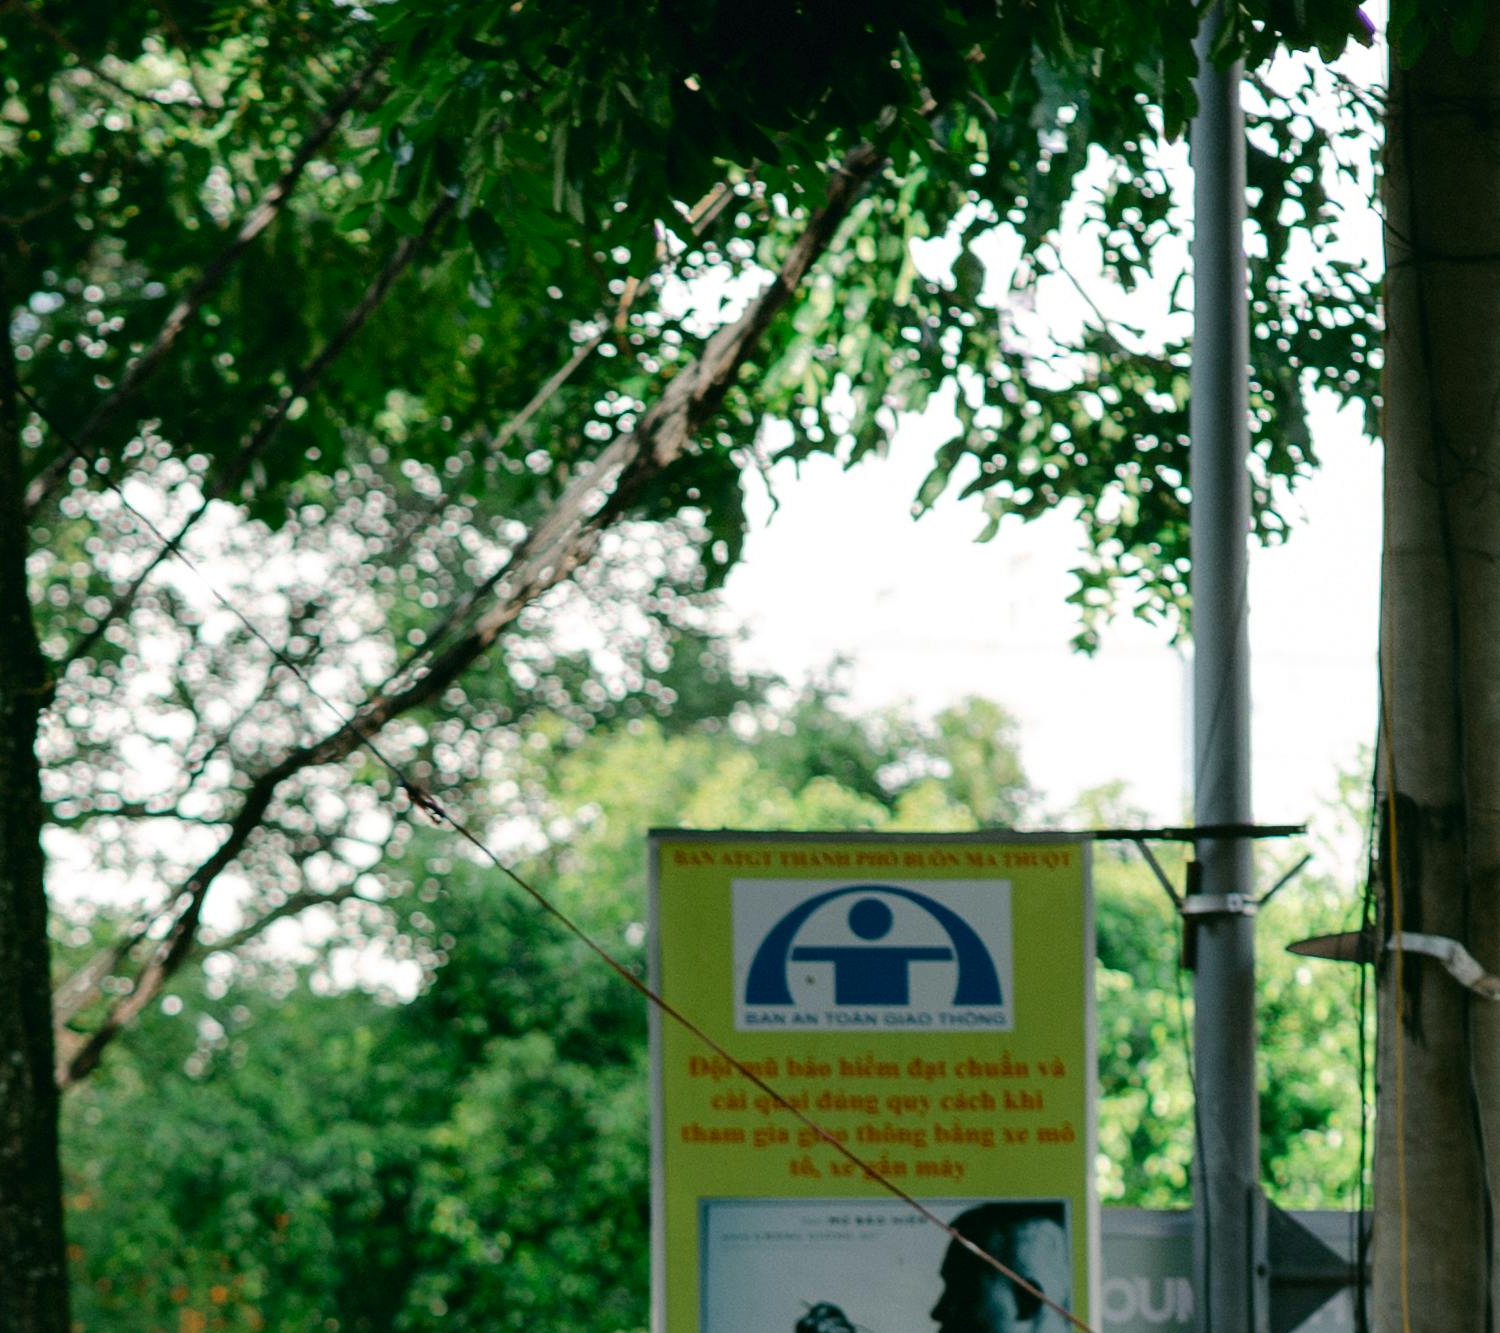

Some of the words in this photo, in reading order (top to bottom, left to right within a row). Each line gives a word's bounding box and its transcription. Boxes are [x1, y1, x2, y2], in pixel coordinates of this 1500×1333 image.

[745, 1012, 786, 1025] BAN
[792, 1012, 818, 1025] AN
[824, 1009, 878, 1025] TOÀN
[884, 1012, 932, 1026] GIAO
[938, 1009, 1006, 1026] THÔNG
[1037, 1056, 1065, 1078] và
[816, 1089, 879, 1115] đúng
[886, 1094, 930, 1116] quy
[940, 1089, 996, 1111] cách
[1004, 1089, 1043, 1111] khi
[680, 1123, 745, 1144] tham
[753, 1125, 790, 1148] gia
[856, 1121, 927, 1148] thông
[1004, 1128, 1028, 1143] xe
[1036, 1121, 1075, 1144] mô
[829, 1161, 854, 1178] xe
[915, 1159, 965, 1183] máy
